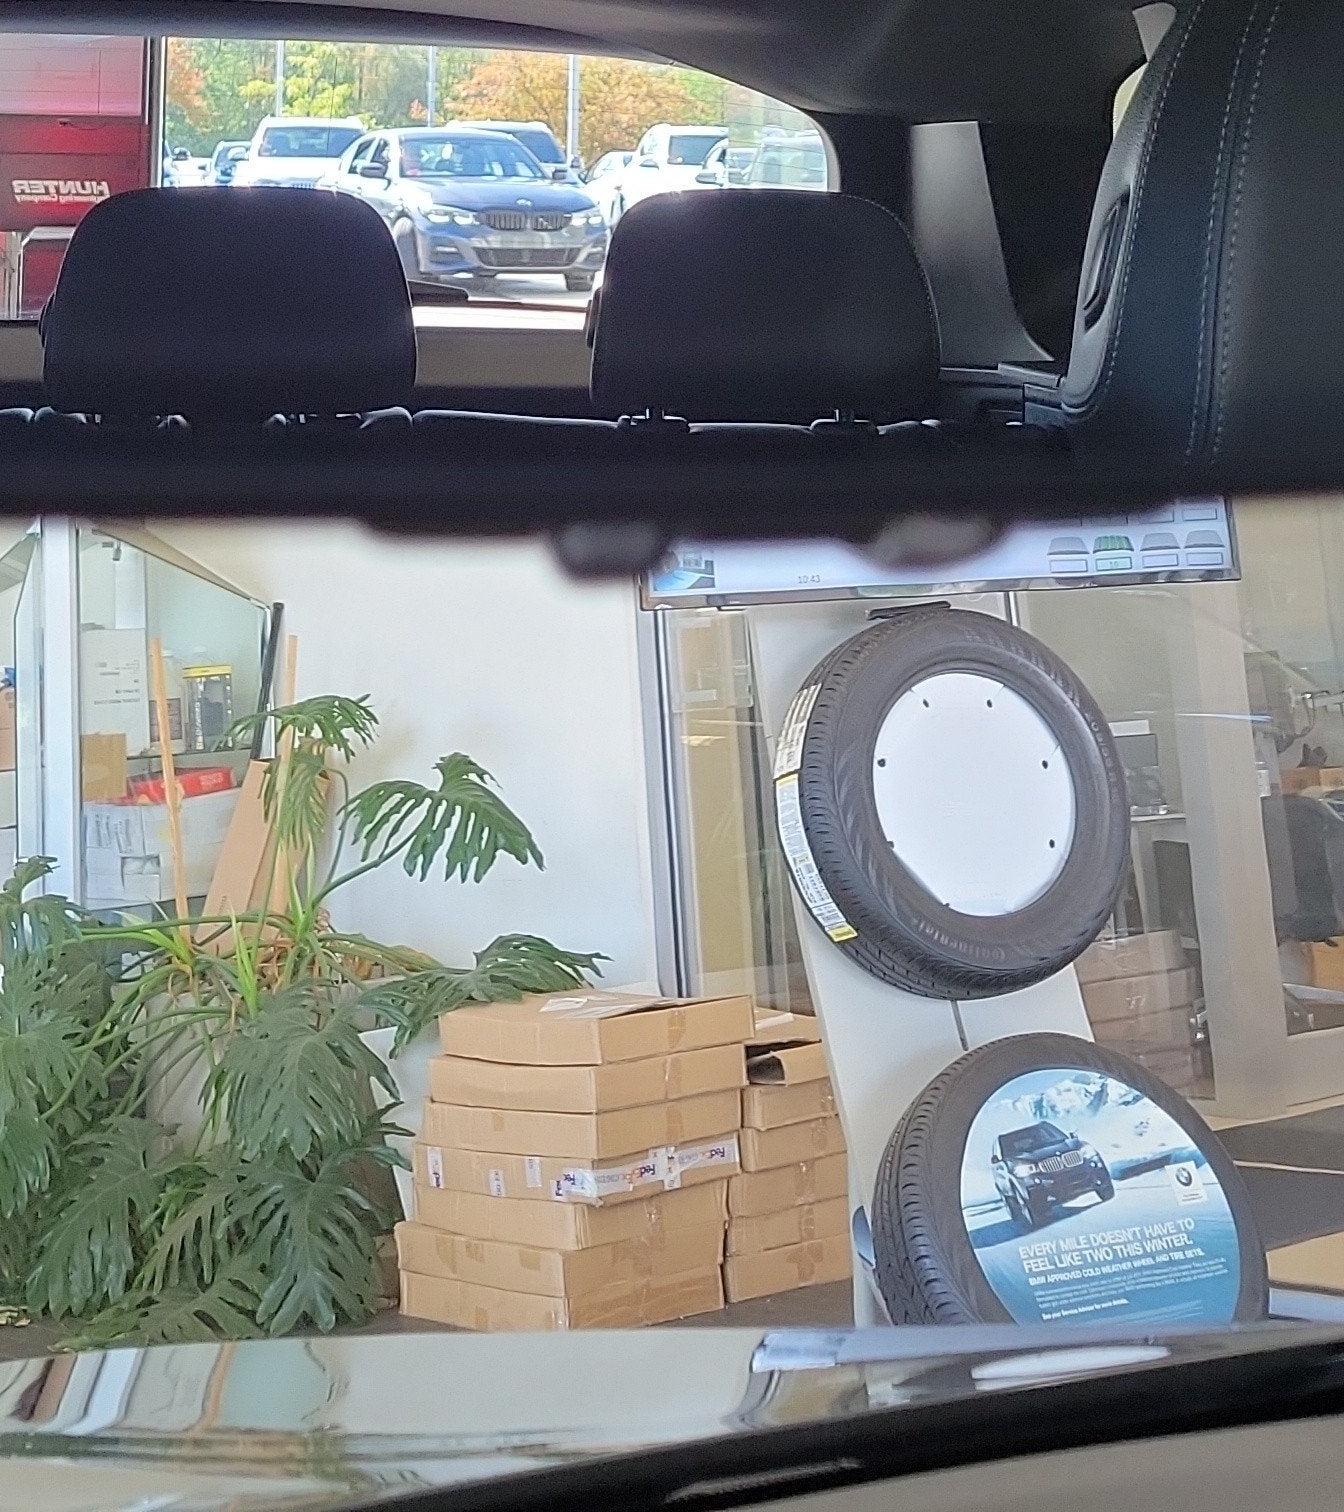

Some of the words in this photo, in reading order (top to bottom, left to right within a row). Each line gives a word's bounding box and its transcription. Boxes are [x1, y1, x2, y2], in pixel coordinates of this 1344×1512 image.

[1018, 1240, 1057, 1259] EVERY
[1058, 1235, 1089, 1251] MILE
[1089, 1226, 1142, 1247] DOESN'T
[1142, 1221, 1177, 1238] HAVE
[1177, 1217, 1195, 1232] TO
[1022, 1256, 1056, 1274] FEEL
[1054, 1251, 1084, 1268] LIKE
[1082, 1246, 1114, 1264] TWO
[1112, 1241, 1144, 1259] THIS
[1142, 1232, 1194, 1254] WINTER.
[1047, 1269, 1083, 1284] APPROVED
[1082, 1266, 1102, 1278] COLD
[1100, 1261, 1133, 1275] WEATHER
